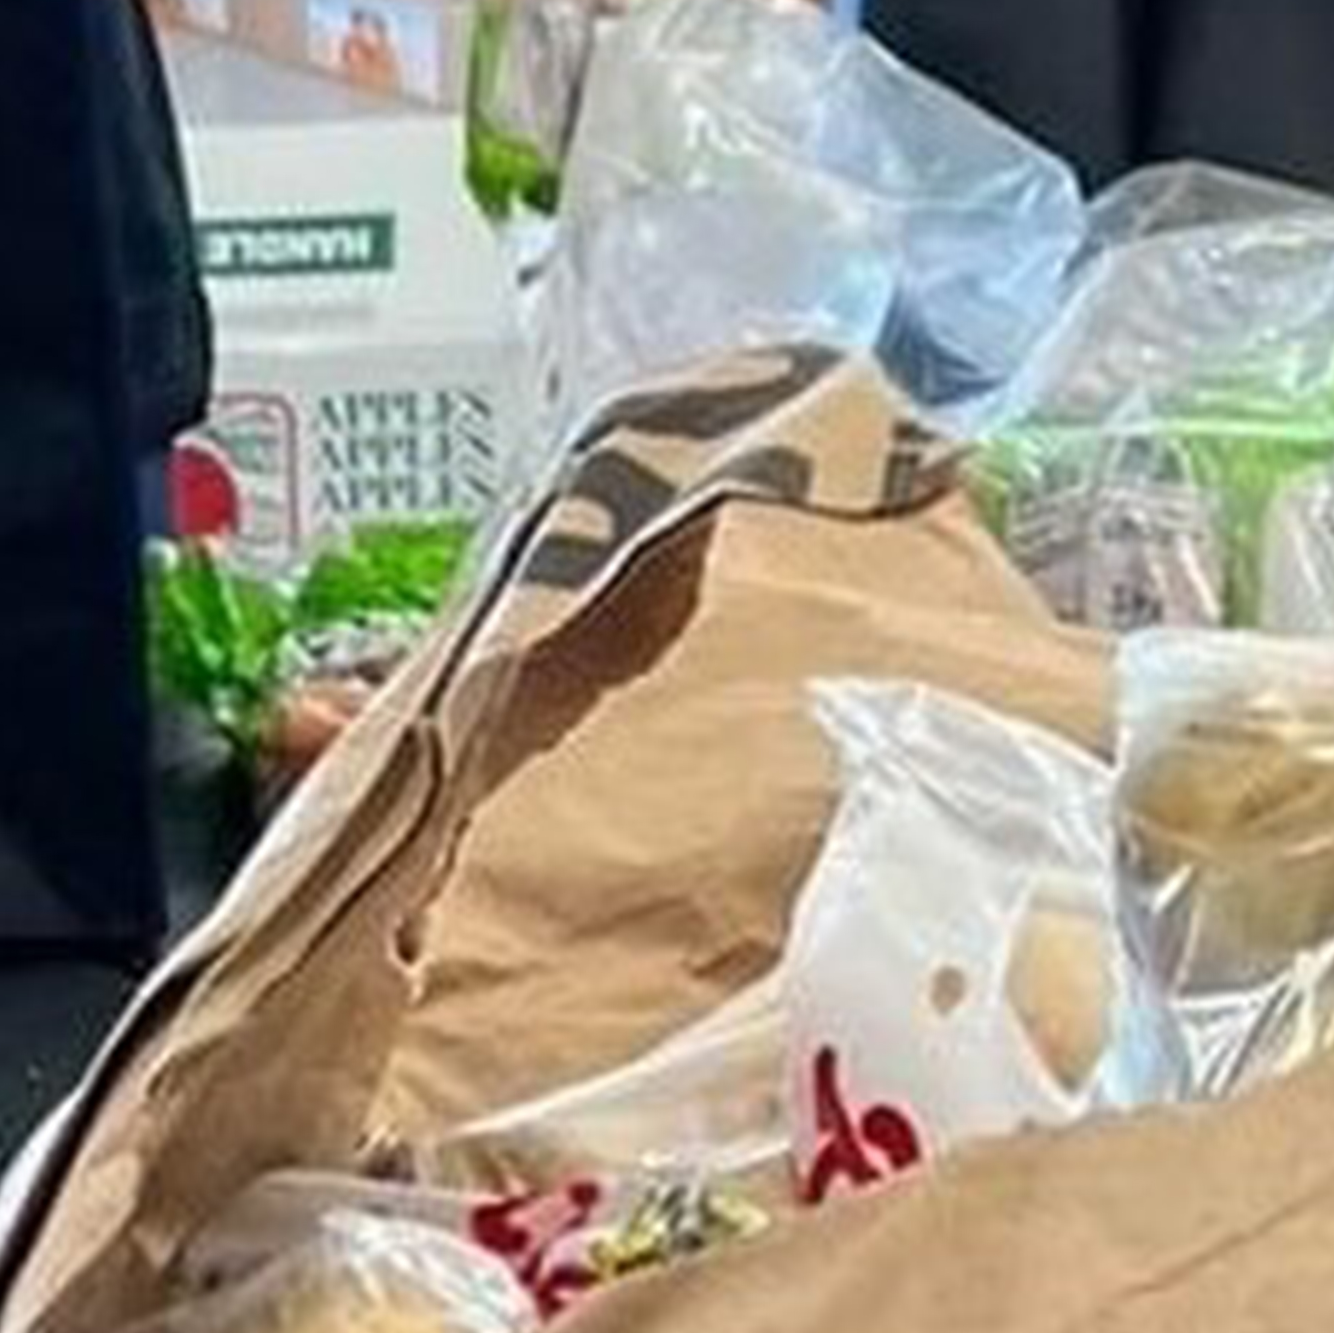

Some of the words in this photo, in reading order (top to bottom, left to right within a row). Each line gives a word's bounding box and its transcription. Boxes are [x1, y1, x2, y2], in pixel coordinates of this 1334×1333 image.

[200, 225, 375, 269] HANDLE
[313, 389, 494, 431] APPLES
[313, 432, 496, 473] APPLES
